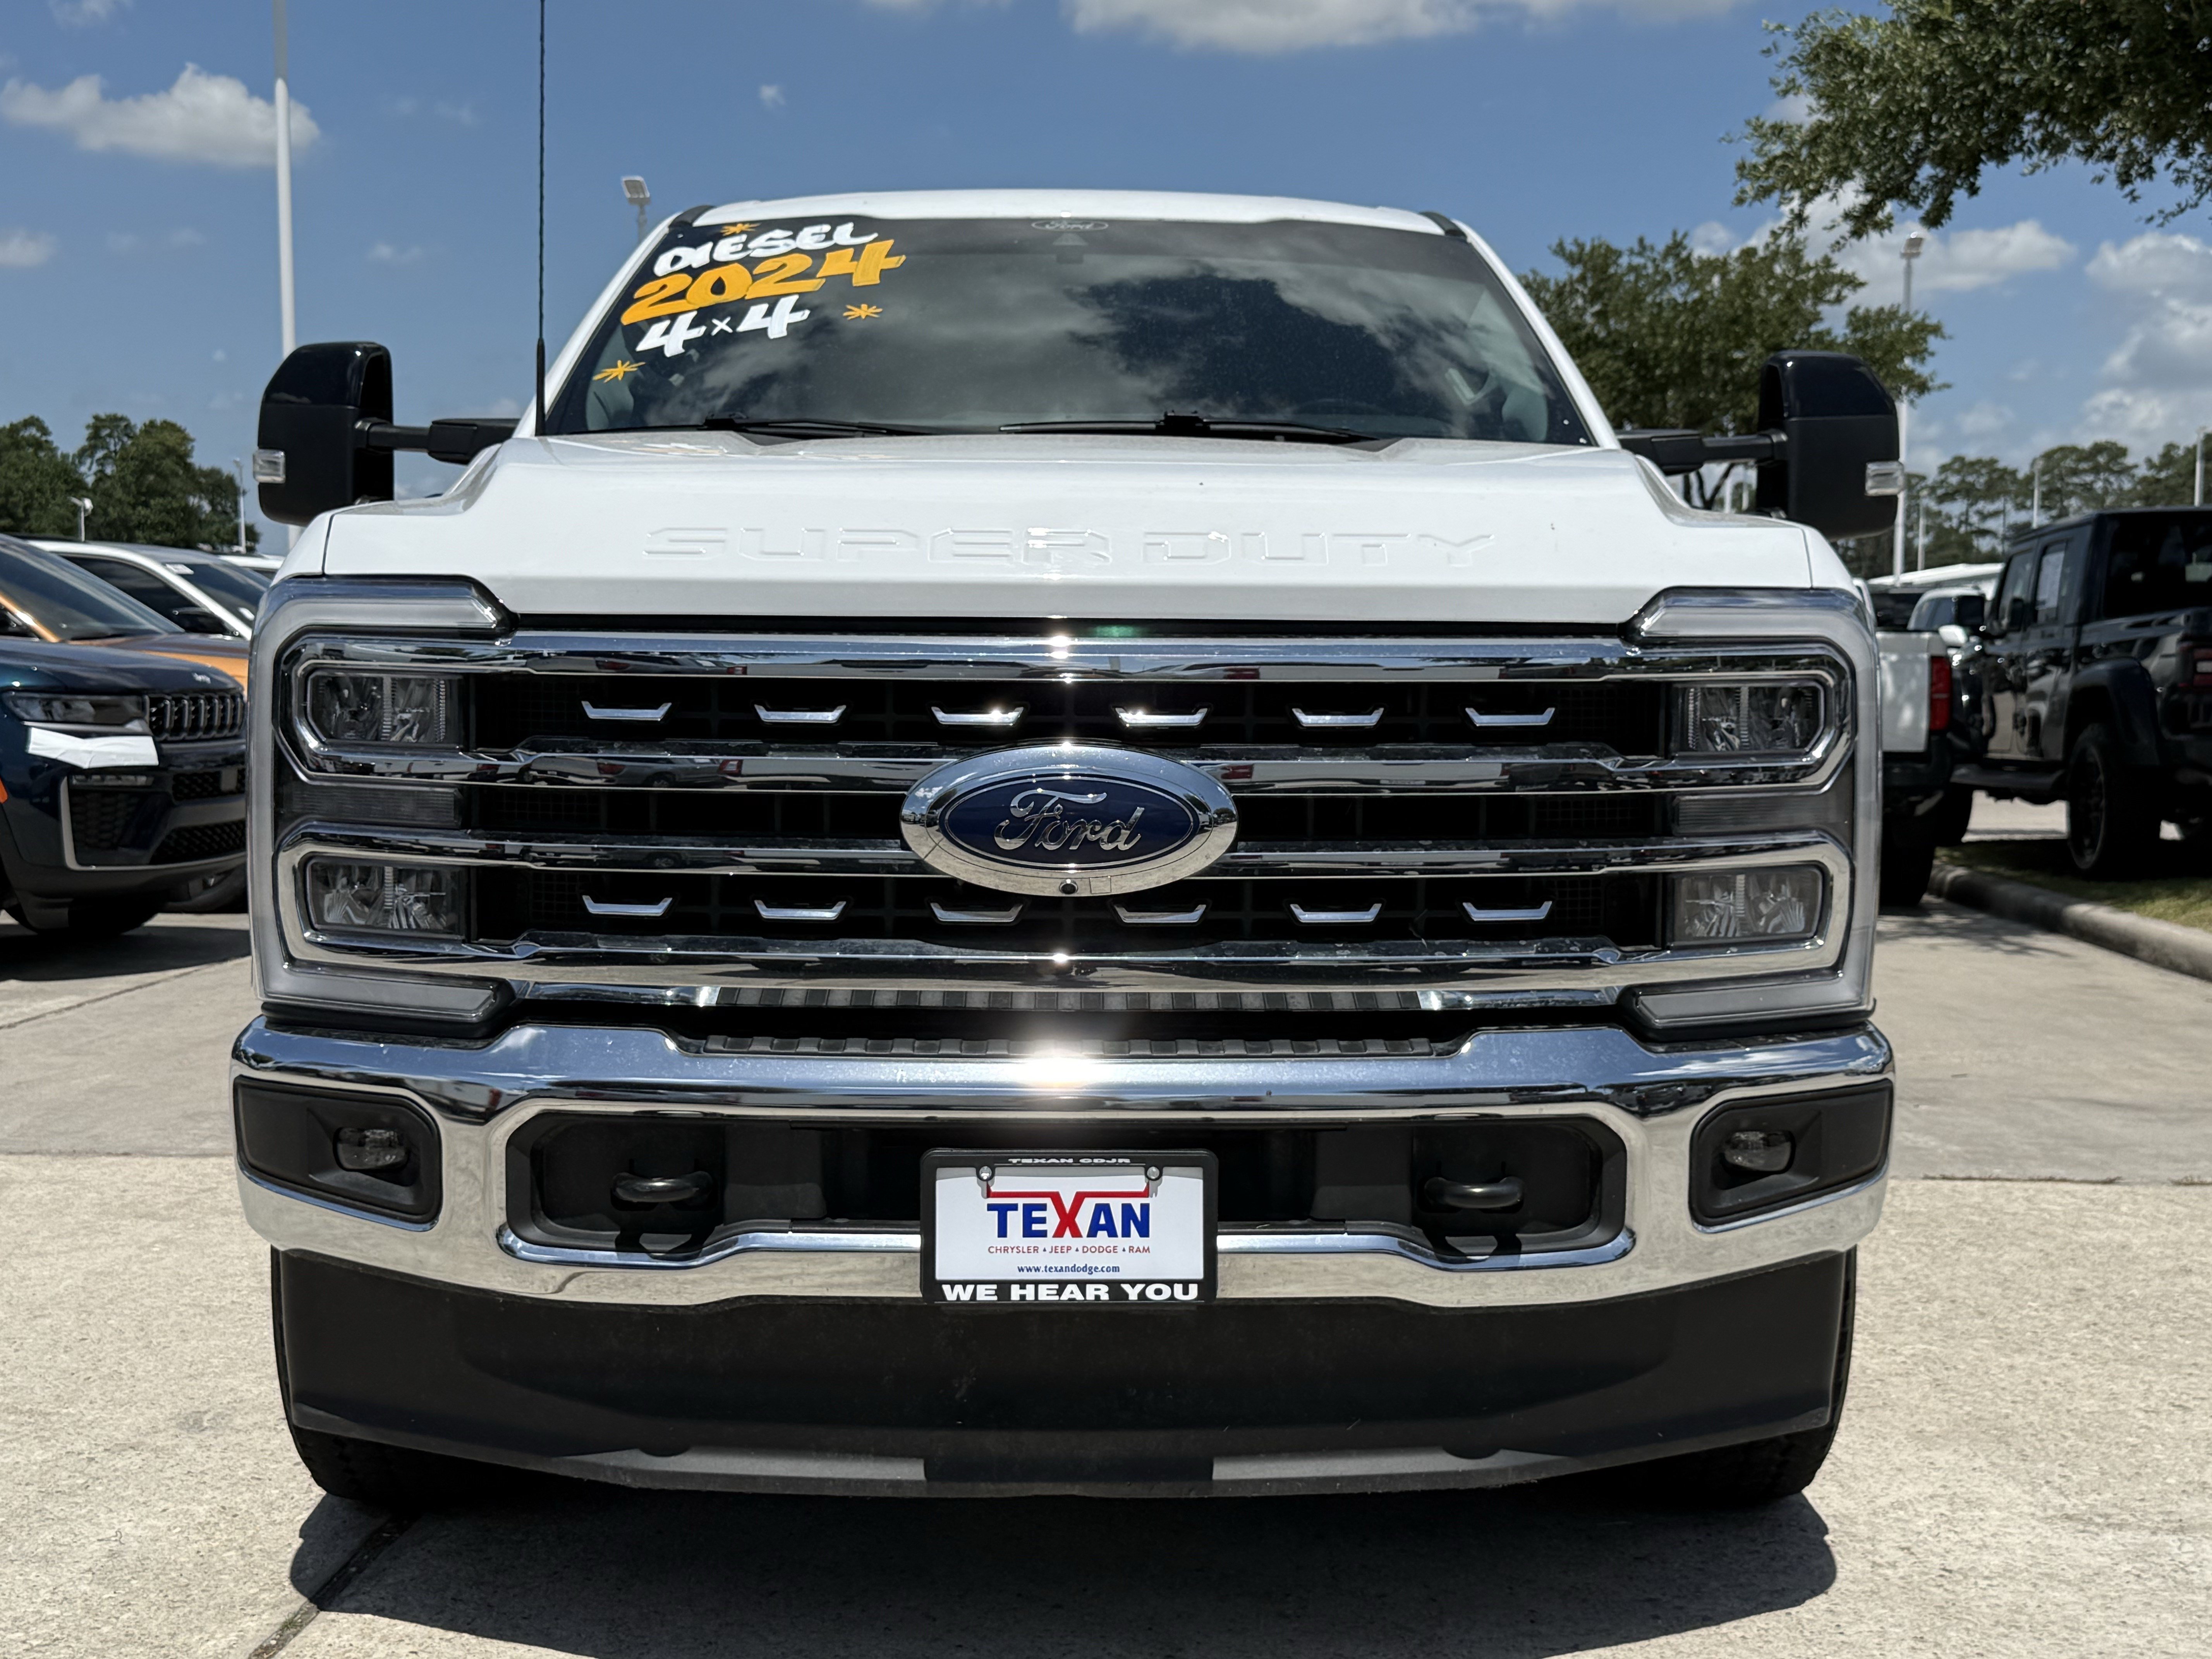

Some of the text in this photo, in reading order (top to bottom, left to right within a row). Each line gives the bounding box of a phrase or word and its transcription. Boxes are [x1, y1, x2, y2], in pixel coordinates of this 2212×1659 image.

[1045, 221, 1094, 230] Ford
[653, 222, 878, 277] DIESEL
[621, 239, 907, 325] 2024
[635, 294, 811, 357] 4x4
[642, 527, 1494, 567] SUPER DUTY
[994, 789, 1145, 850] Ford
[987, 1191, 1150, 1238] TEXAN
[988, 1245, 1151, 1254] CHRYSLER JEEP DODGE RAM
[1017, 1263, 1120, 1275] www.texandodge.com
[942, 1283, 1199, 1302] WE HEAR YOU
